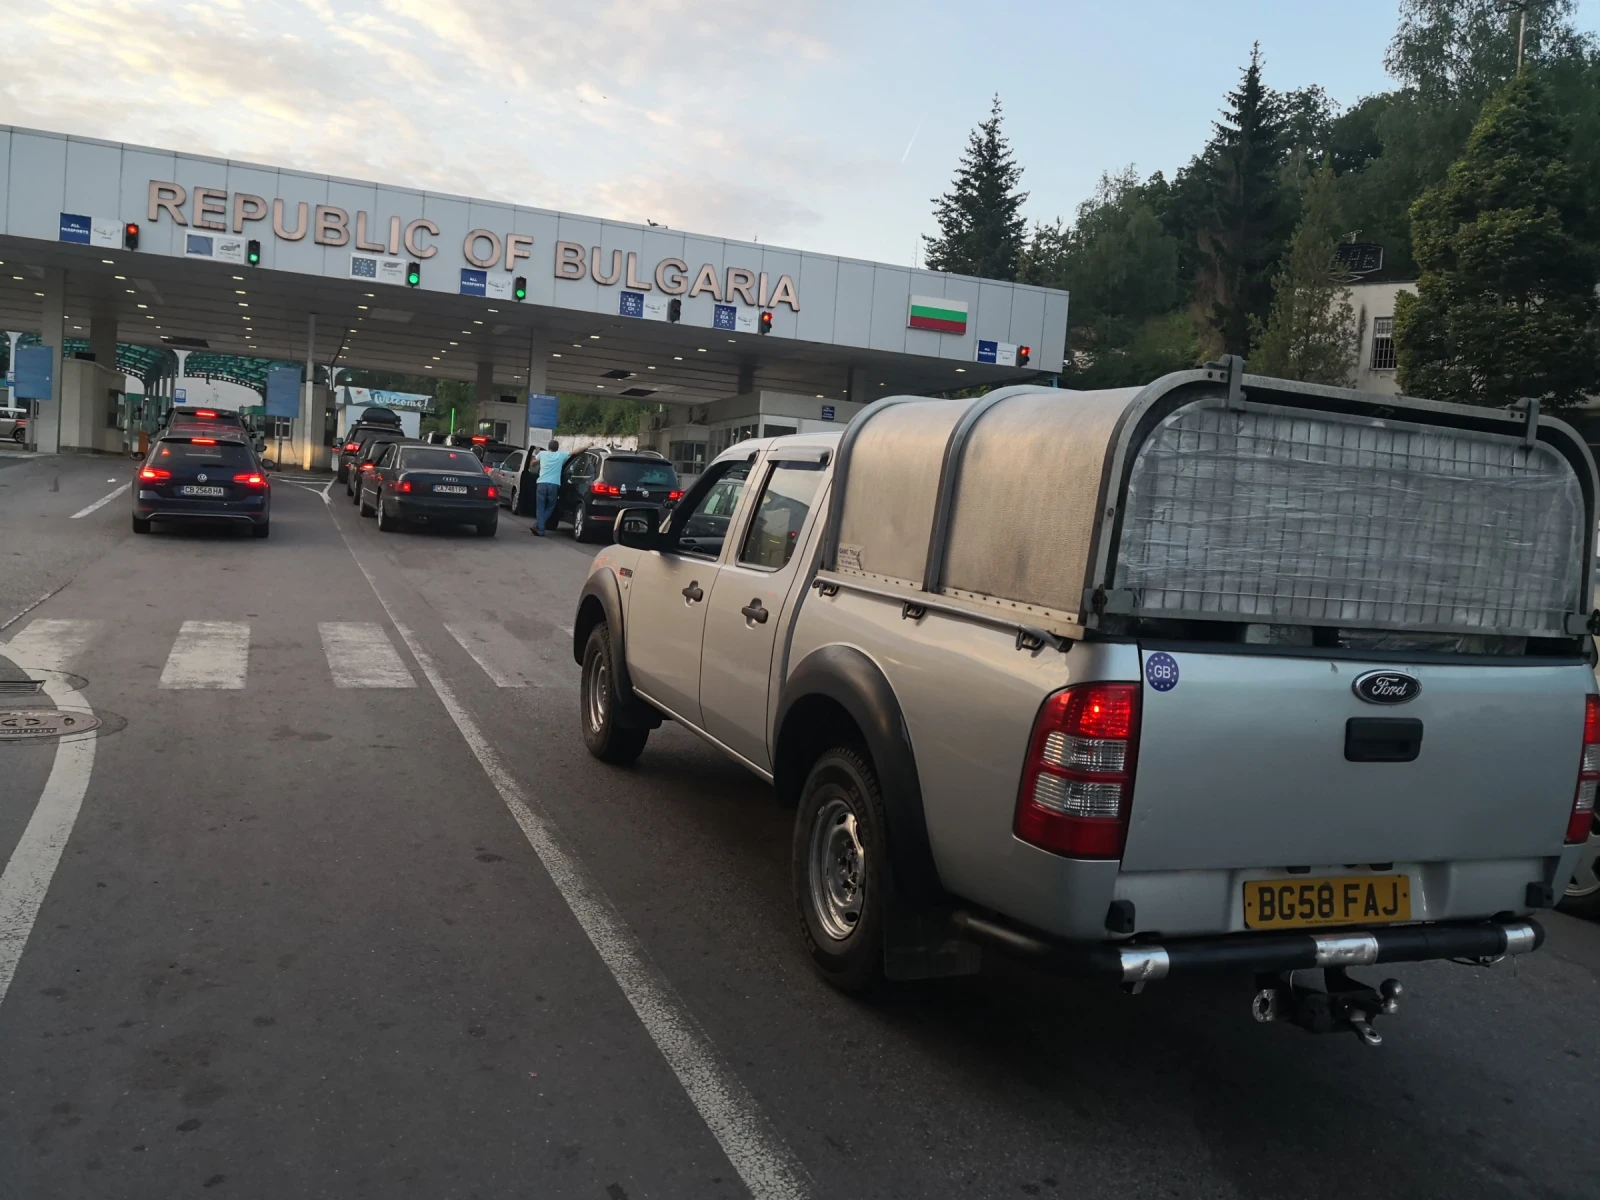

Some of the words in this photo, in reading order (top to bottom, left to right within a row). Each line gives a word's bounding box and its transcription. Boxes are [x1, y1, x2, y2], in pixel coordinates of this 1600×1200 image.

[61, 227, 89, 235] PASSPORTS
[148, 180, 440, 258] REPUBLIC
[463, 229, 534, 271] OF
[555, 241, 800, 311] BULGARIA
[374, 393, 431, 411] Welcome!
[185, 486, 194, 494] CB
[195, 486, 213, 495] 2568
[1154, 664, 1171, 679] GB
[1371, 676, 1408, 696] Ford
[1258, 885, 1335, 921] BG58
[1343, 882, 1399, 917] FAJ
